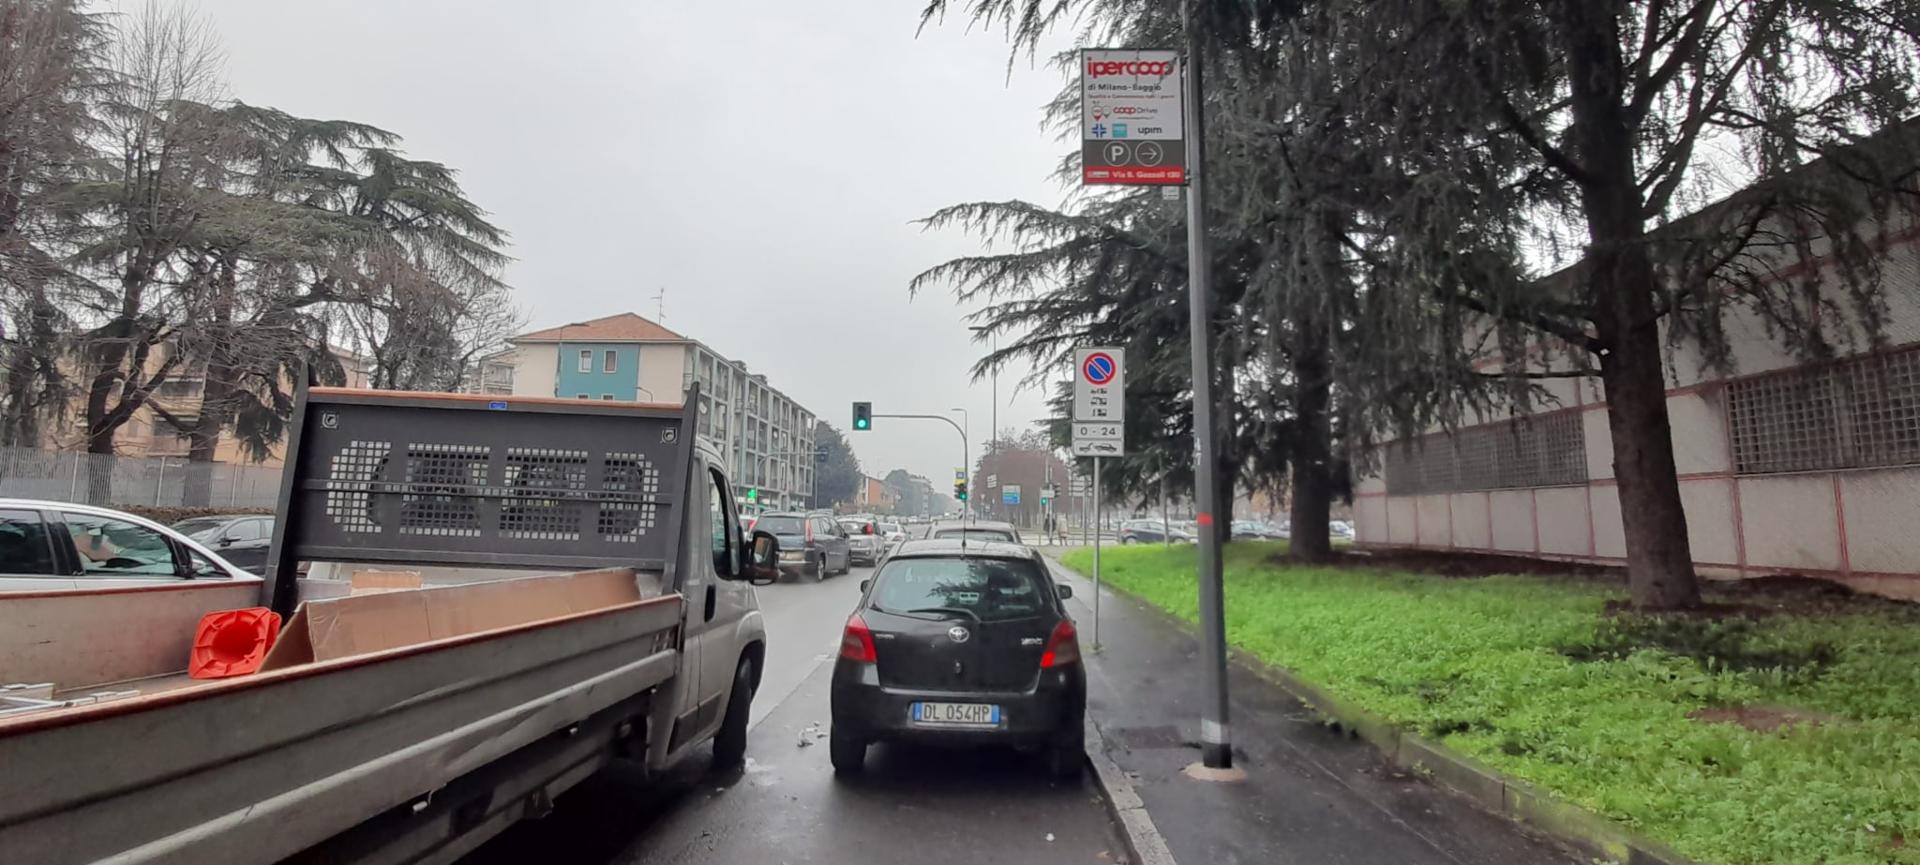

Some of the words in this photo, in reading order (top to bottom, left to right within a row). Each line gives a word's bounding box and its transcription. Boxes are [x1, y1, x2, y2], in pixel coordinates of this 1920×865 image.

[1087, 57, 1174, 79] ipercoop
[1087, 83, 1096, 91] di
[1113, 106, 1136, 116] coop
[1136, 106, 1158, 114] Drive
[1137, 126, 1163, 136] upim
[1111, 146, 1124, 162] P
[1112, 170, 1126, 178] Via
[1080, 426, 1088, 436] 0
[1101, 426, 1116, 436] 24
[923, 704, 941, 720] DL
[946, 704, 990, 722] 054HP
